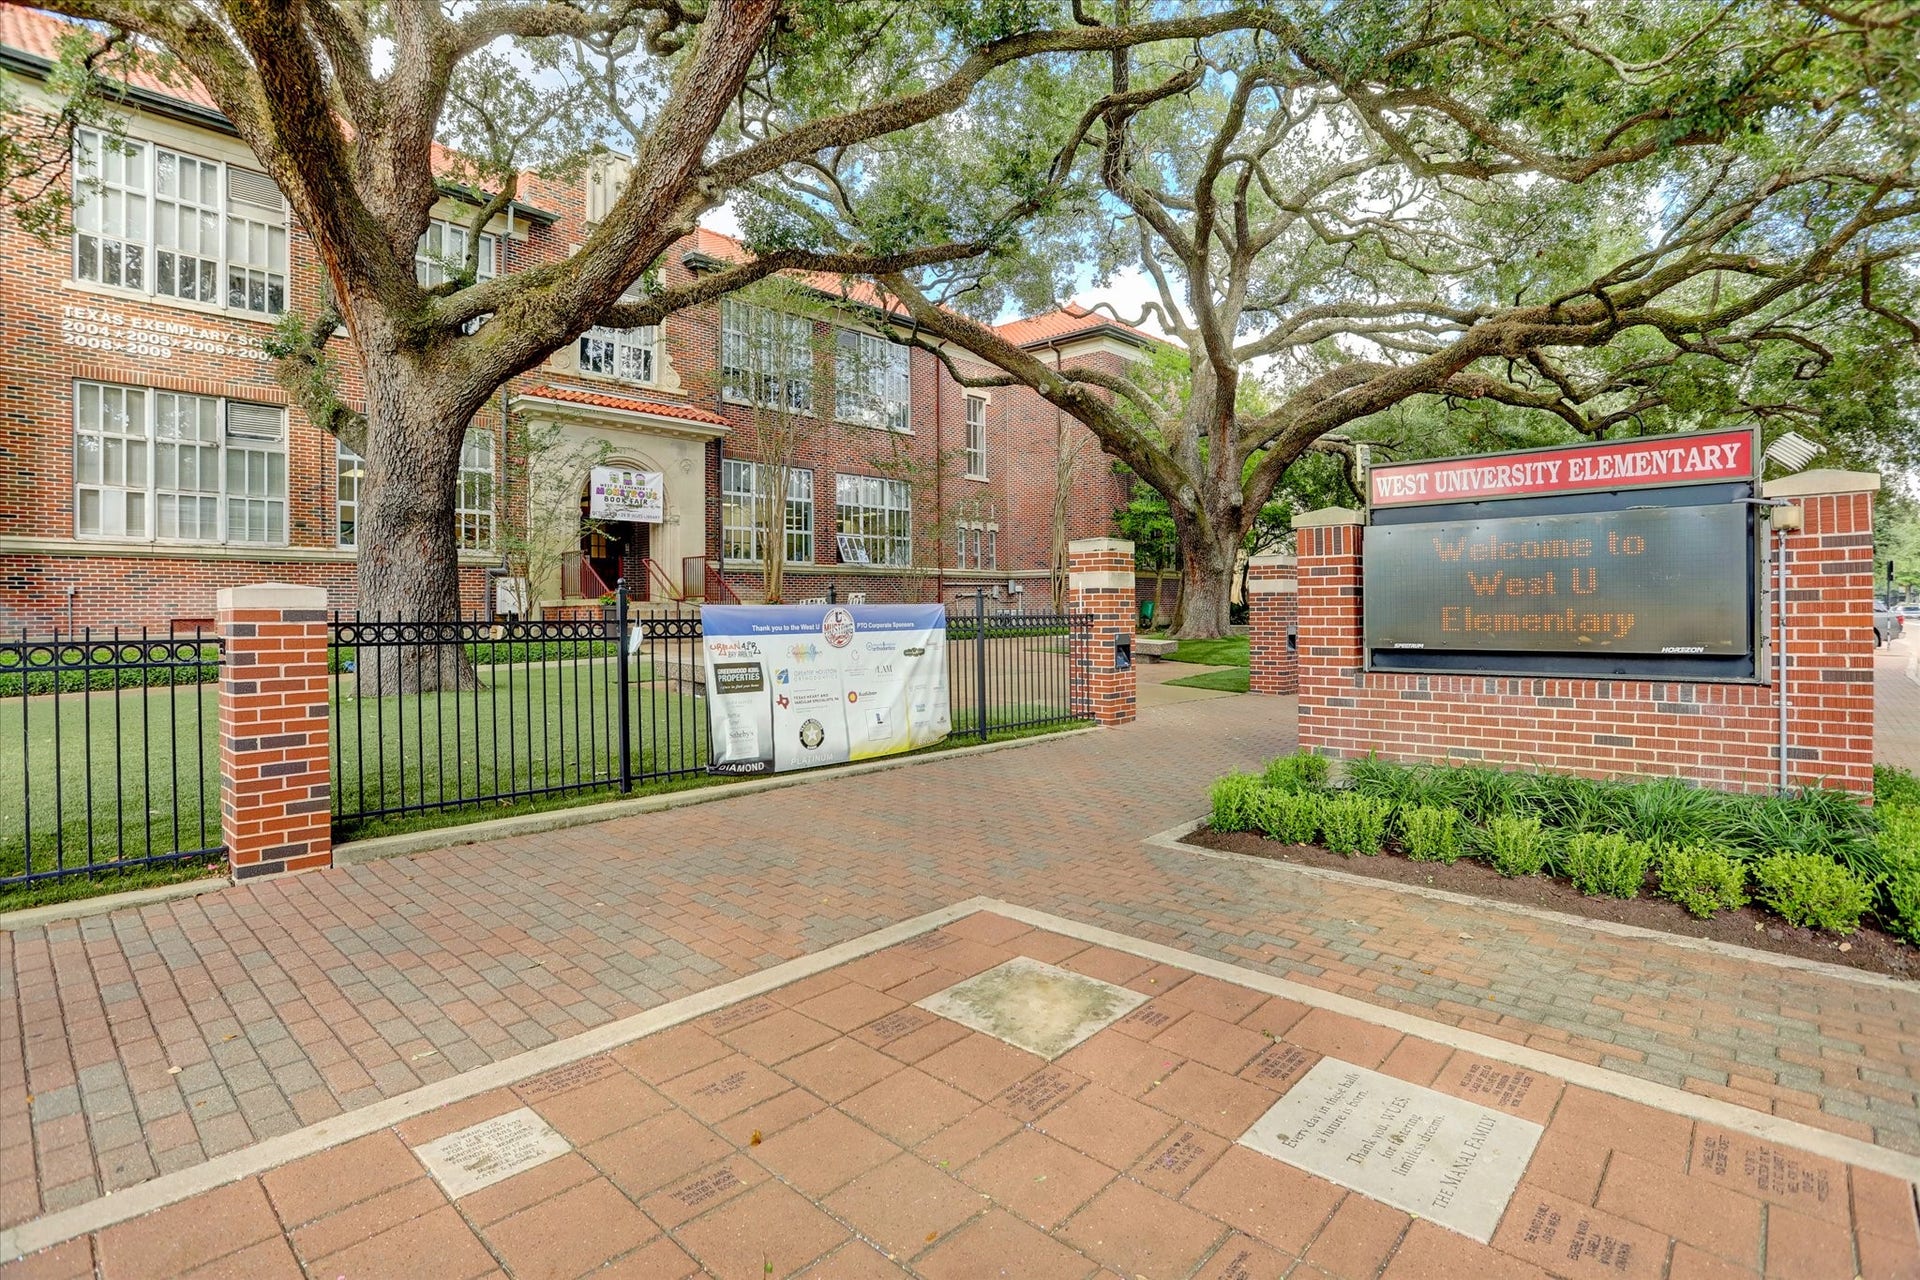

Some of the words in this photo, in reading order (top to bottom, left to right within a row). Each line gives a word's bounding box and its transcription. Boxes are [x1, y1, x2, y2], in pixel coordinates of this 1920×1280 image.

[62, 306, 124, 326] TEXAS
[132, 317, 231, 343] EXEMPLARY
[62, 319, 110, 337] 2004
[127, 330, 171, 346] 2005
[184, 338, 225, 355] 2006
[63, 333, 112, 350] 2008
[125, 342, 172, 359] 2009
[1376, 473, 1429, 497] WEST
[1434, 460, 1562, 493] UNIVERSITY
[1568, 443, 1741, 482] ELEMENTARY
[596, 487, 657, 500] MONSTROUS
[604, 496, 626, 504] BOOK
[1432, 535, 1592, 561] Welcome
[1608, 531, 1645, 555] to
[1467, 570, 1557, 596] West
[1572, 567, 1597, 594] U
[893, 621, 914, 629] Sponsors
[1441, 606, 1635, 638] Elementary
[718, 673, 760, 682] PROPERTIES
[719, 762, 765, 773] DIAMOND
[790, 754, 833, 766] PLATINUM
[1336, 1071, 1361, 1088] halls
[1320, 1086, 1348, 1106] these
[1345, 1087, 1370, 1107] born.
[1313, 1103, 1331, 1114] in
[1338, 1105, 1354, 1115] is
[1299, 1111, 1325, 1129] day
[1317, 1112, 1347, 1137] future
[1386, 1111, 1424, 1147] fostering
[1280, 1125, 1313, 1149] Every
[1315, 1136, 1327, 1144] a
[1463, 1113, 1497, 1150] FAMILY
[1345, 1136, 1378, 1165] Thank
[1376, 1143, 1397, 1159] for
[1390, 1139, 1427, 1177] limitless
[1439, 1147, 1477, 1189] MANAL
[1431, 1188, 1454, 1210] THE
